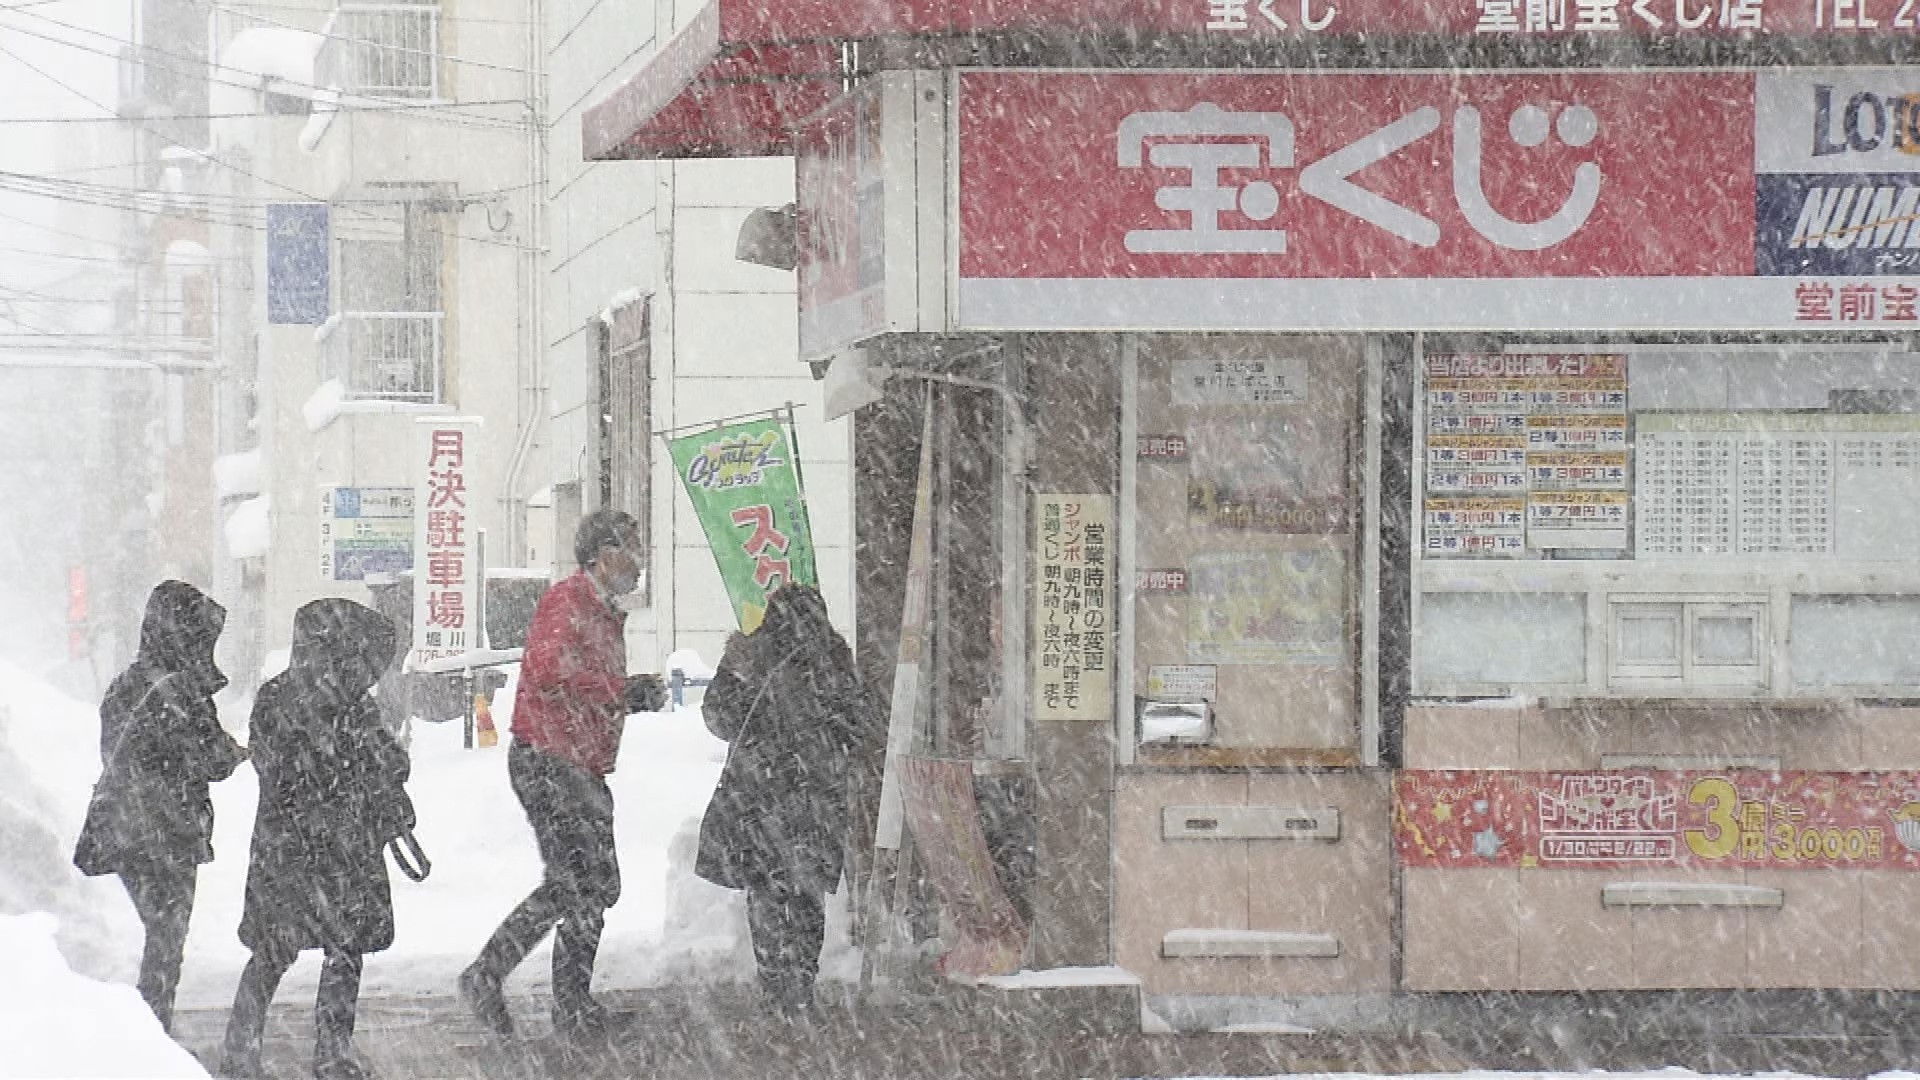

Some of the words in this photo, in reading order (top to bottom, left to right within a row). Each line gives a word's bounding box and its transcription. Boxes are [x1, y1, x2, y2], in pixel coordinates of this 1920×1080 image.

[1117, 102, 1601, 255] 宝くじ
[1795, 281, 1918, 321] 堂前宝
[426, 429, 466, 629] 月決駐車場
[1083, 523, 1105, 671] 営業時間の変更
